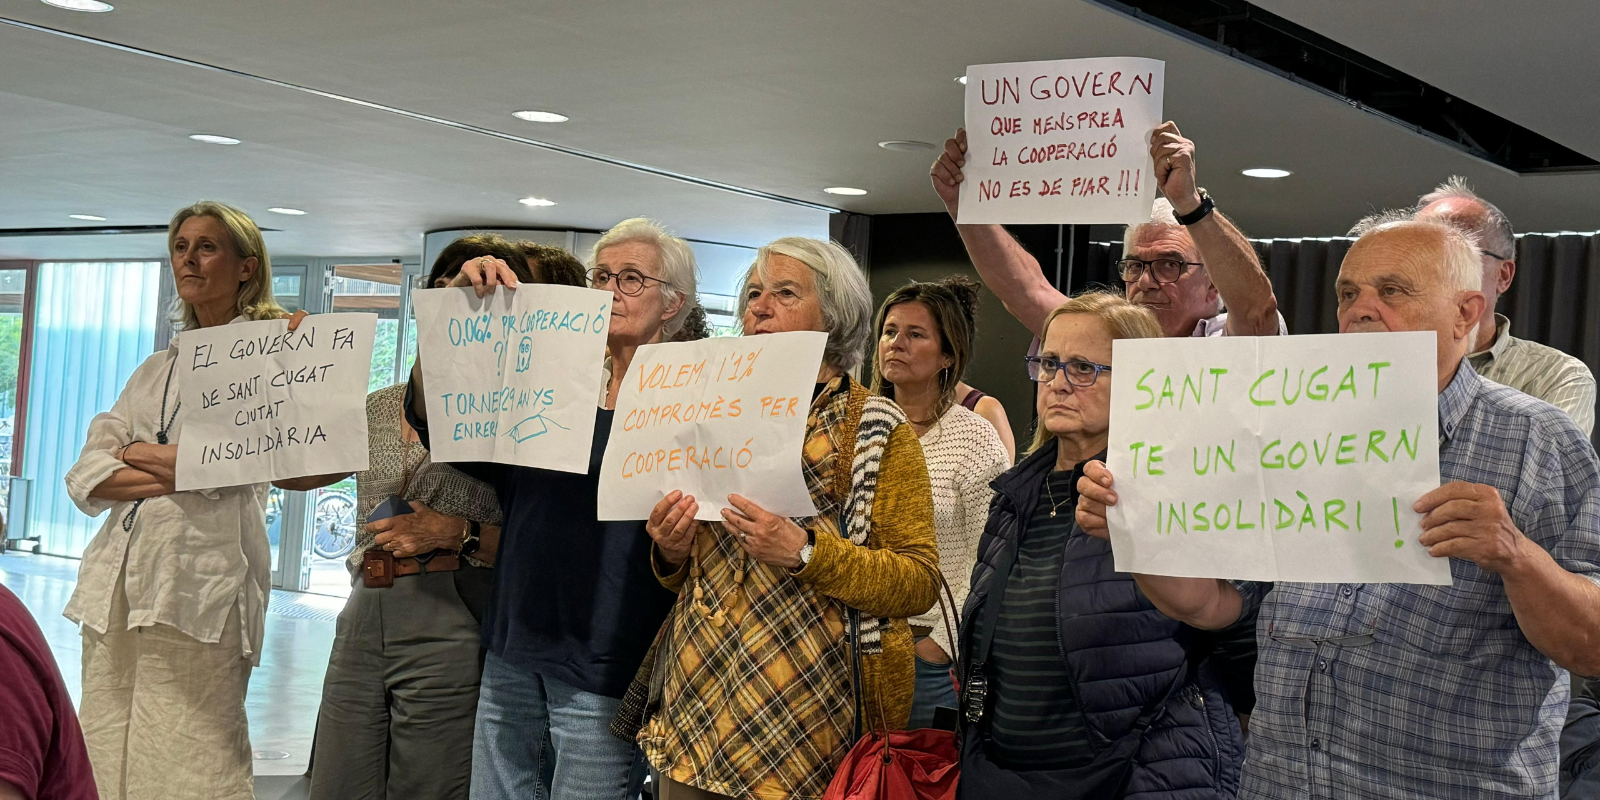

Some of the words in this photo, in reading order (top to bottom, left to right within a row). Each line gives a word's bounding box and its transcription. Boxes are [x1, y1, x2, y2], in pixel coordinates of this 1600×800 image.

[981, 76, 1020, 105] UN
[1030, 71, 1153, 100] GOVERN
[990, 116, 1022, 137] QUE
[1033, 107, 1125, 135] MENSPREA
[992, 147, 1008, 166] LA
[1018, 134, 1117, 165] COOPERACIÓ
[978, 179, 1001, 202] NO
[1009, 180, 1031, 199] ES
[1038, 178, 1063, 196] DE
[1070, 176, 1110, 196] FIAR
[448, 312, 492, 347] 0,06%
[520, 303, 607, 334] COOPERACIÓ
[192, 344, 218, 371] EL
[229, 326, 315, 360] GOVERN
[332, 327, 354, 350] FA
[202, 389, 220, 409] DE
[227, 375, 260, 401] SANT
[270, 364, 334, 388] CUGAT
[638, 359, 707, 393] VOLEM
[1134, 367, 1228, 411] SANT
[1248, 361, 1391, 406] CUGAT
[234, 400, 284, 426] CIUTAT
[441, 391, 500, 417] TORNE
[623, 395, 742, 432] COMPROMÈS
[760, 396, 799, 418] PER
[201, 425, 327, 465] INSOLIDÀRIA
[453, 420, 498, 441] ENRER
[621, 437, 754, 479] COOPERACIÓ
[1129, 441, 1167, 478] TE
[1193, 439, 1236, 476] UN
[1259, 424, 1421, 470] GOVERN
[1157, 489, 1362, 535] INSOLIDÀRI
